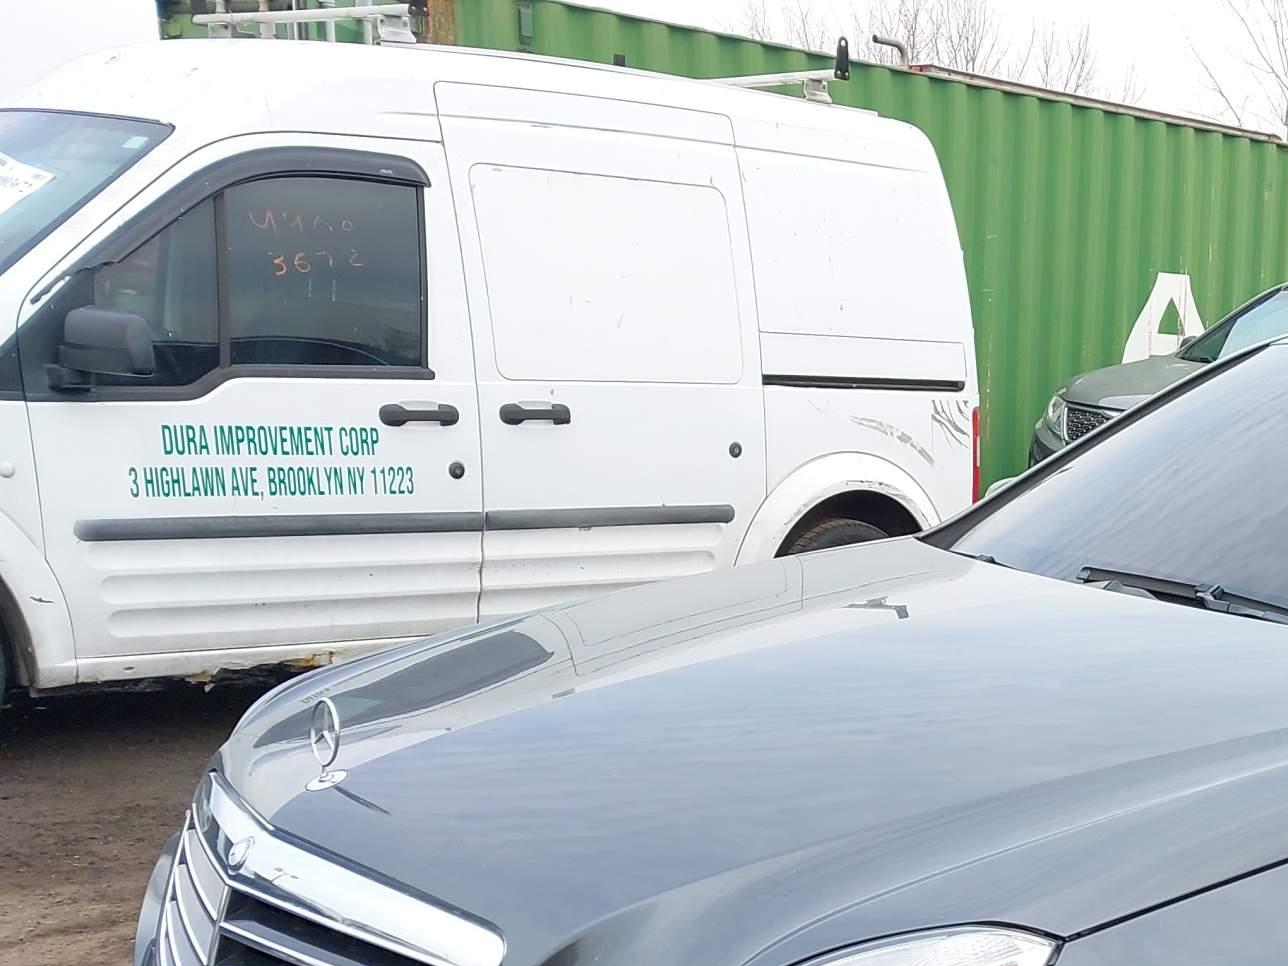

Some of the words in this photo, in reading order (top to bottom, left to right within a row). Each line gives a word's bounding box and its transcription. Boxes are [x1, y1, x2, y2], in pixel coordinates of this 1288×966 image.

[160, 424, 210, 456] DURA
[213, 425, 334, 456] IMPROVEMENT
[339, 427, 380, 456] CORP
[128, 466, 140, 498] 3
[143, 466, 227, 497] HIGHLAWN
[231, 466, 265, 501] AVE,
[267, 466, 344, 497] BROOKLYN
[348, 466, 367, 495] NY
[370, 466, 415, 495] 11223
